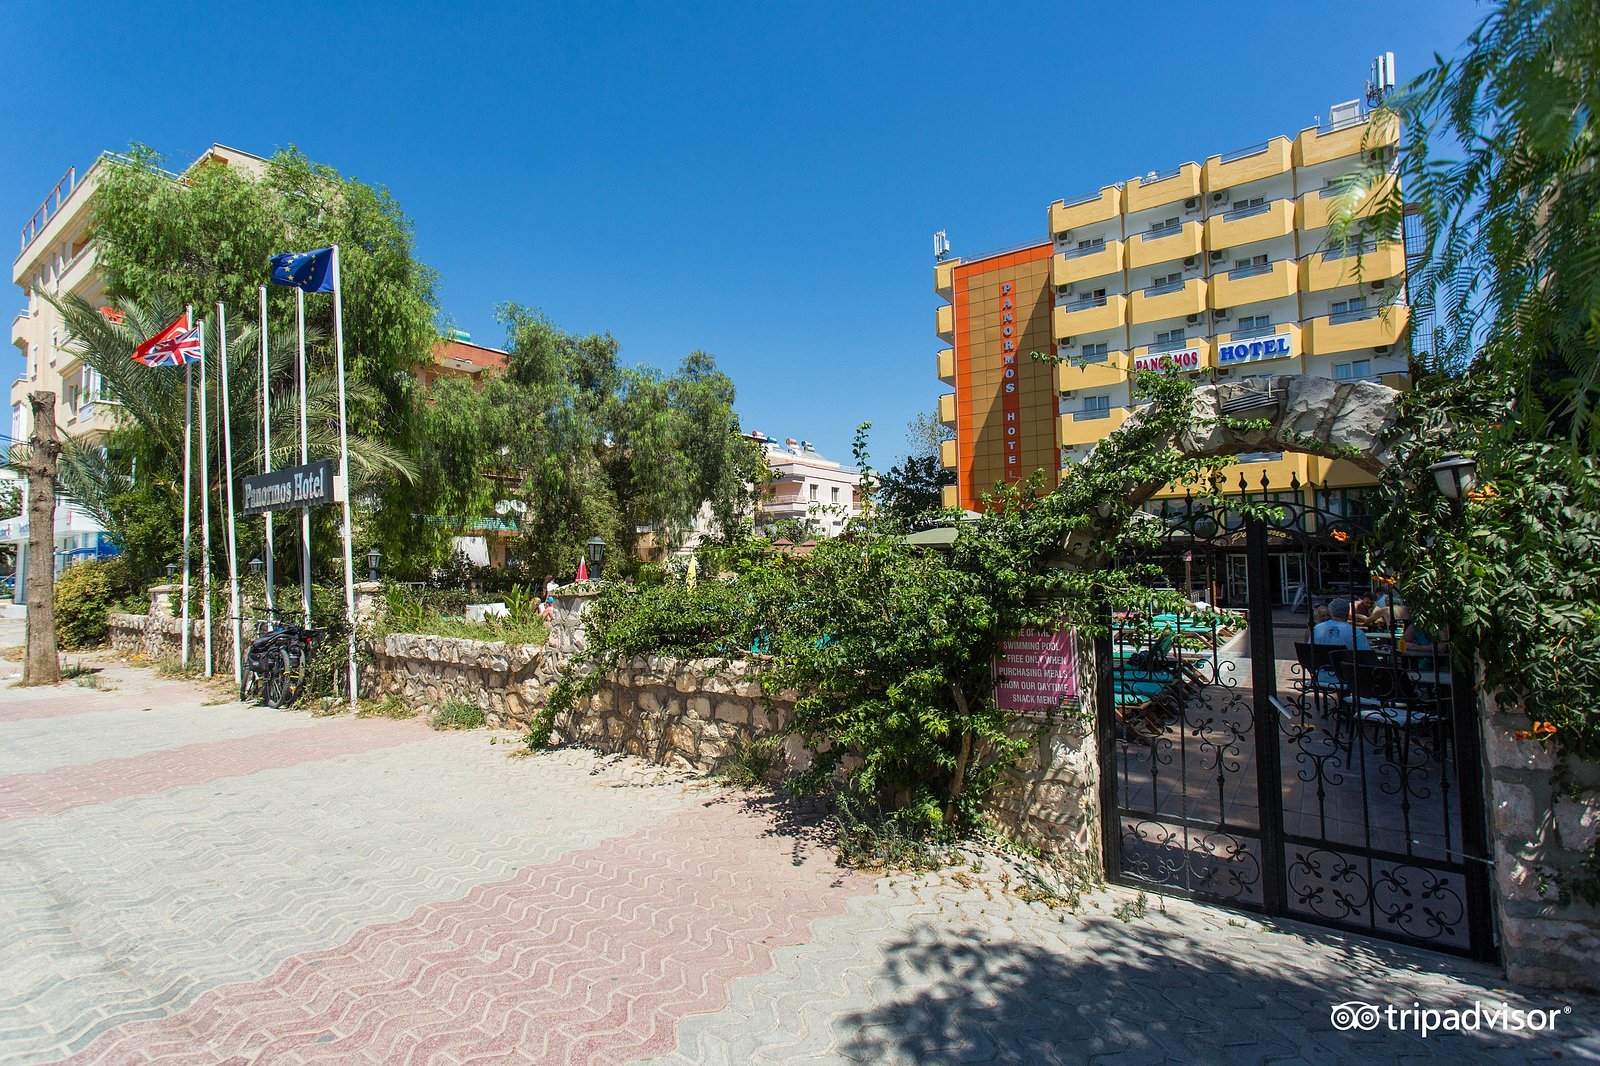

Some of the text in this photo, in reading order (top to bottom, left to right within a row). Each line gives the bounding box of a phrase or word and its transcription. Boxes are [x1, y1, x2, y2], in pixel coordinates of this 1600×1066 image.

[1220, 338, 1290, 361] HOTEL
[1136, 351, 1198, 371] PANOMOS
[1002, 283, 1017, 479] PANORMOS HOTEL
[244, 467, 324, 509] Panormos Hotel
[1003, 641, 1060, 651] SWIMMING POOL
[1007, 654, 1067, 665] FREE ONLY WHEN
[999, 668, 1068, 679] PURCHASING MEALS
[1000, 681, 1069, 692] FROM OUR DAYTIME
[1012, 693, 1035, 703] SNACK
[1036, 695, 1057, 705] MENU
